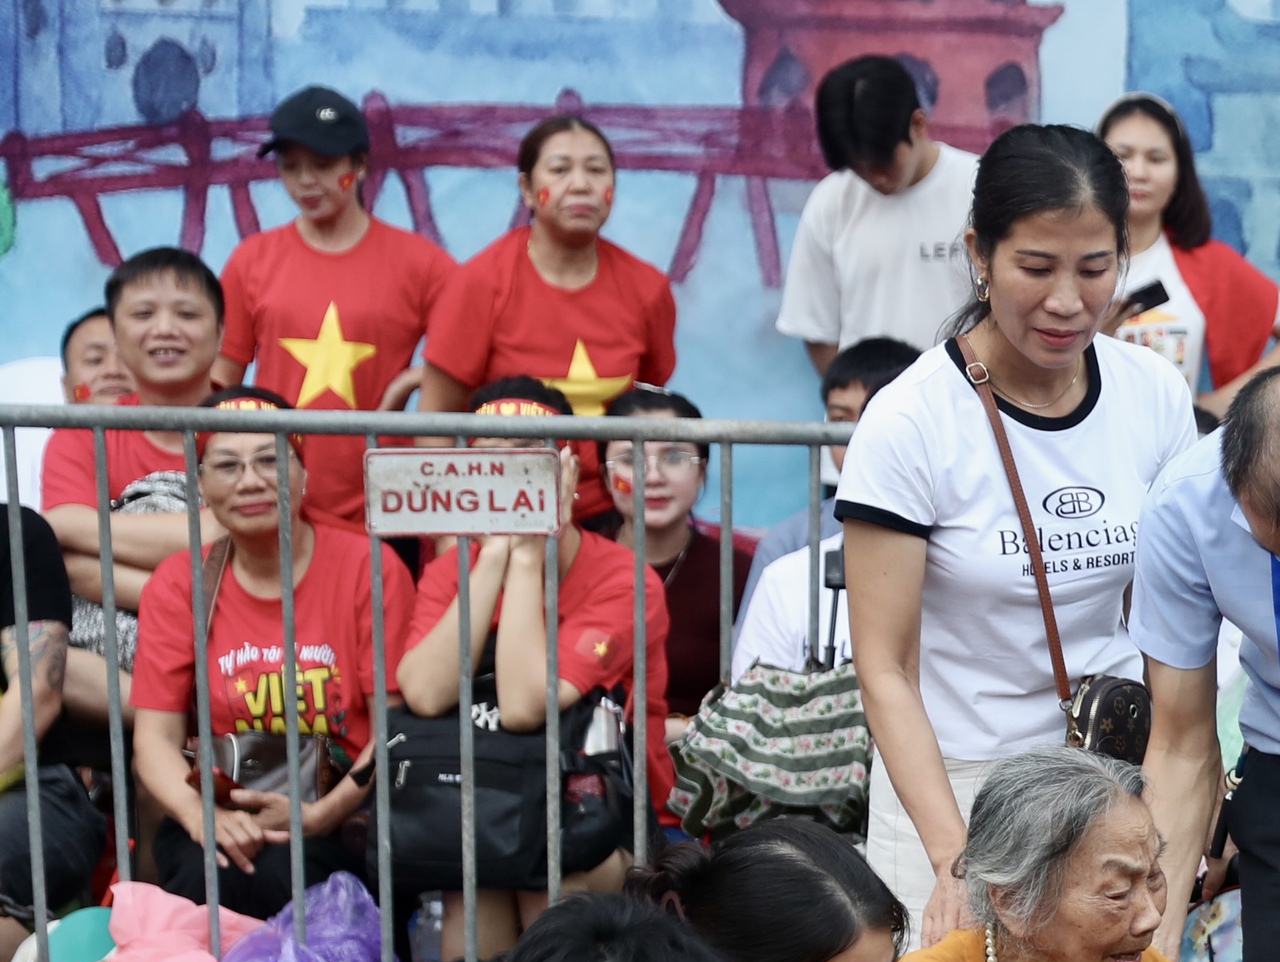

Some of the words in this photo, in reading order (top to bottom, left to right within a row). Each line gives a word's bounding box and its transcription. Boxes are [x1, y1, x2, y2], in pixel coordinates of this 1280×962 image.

[420, 461, 505, 477] C.A.H.N
[381, 480, 480, 513] DỪNG
[1072, 558, 1082, 571] &
